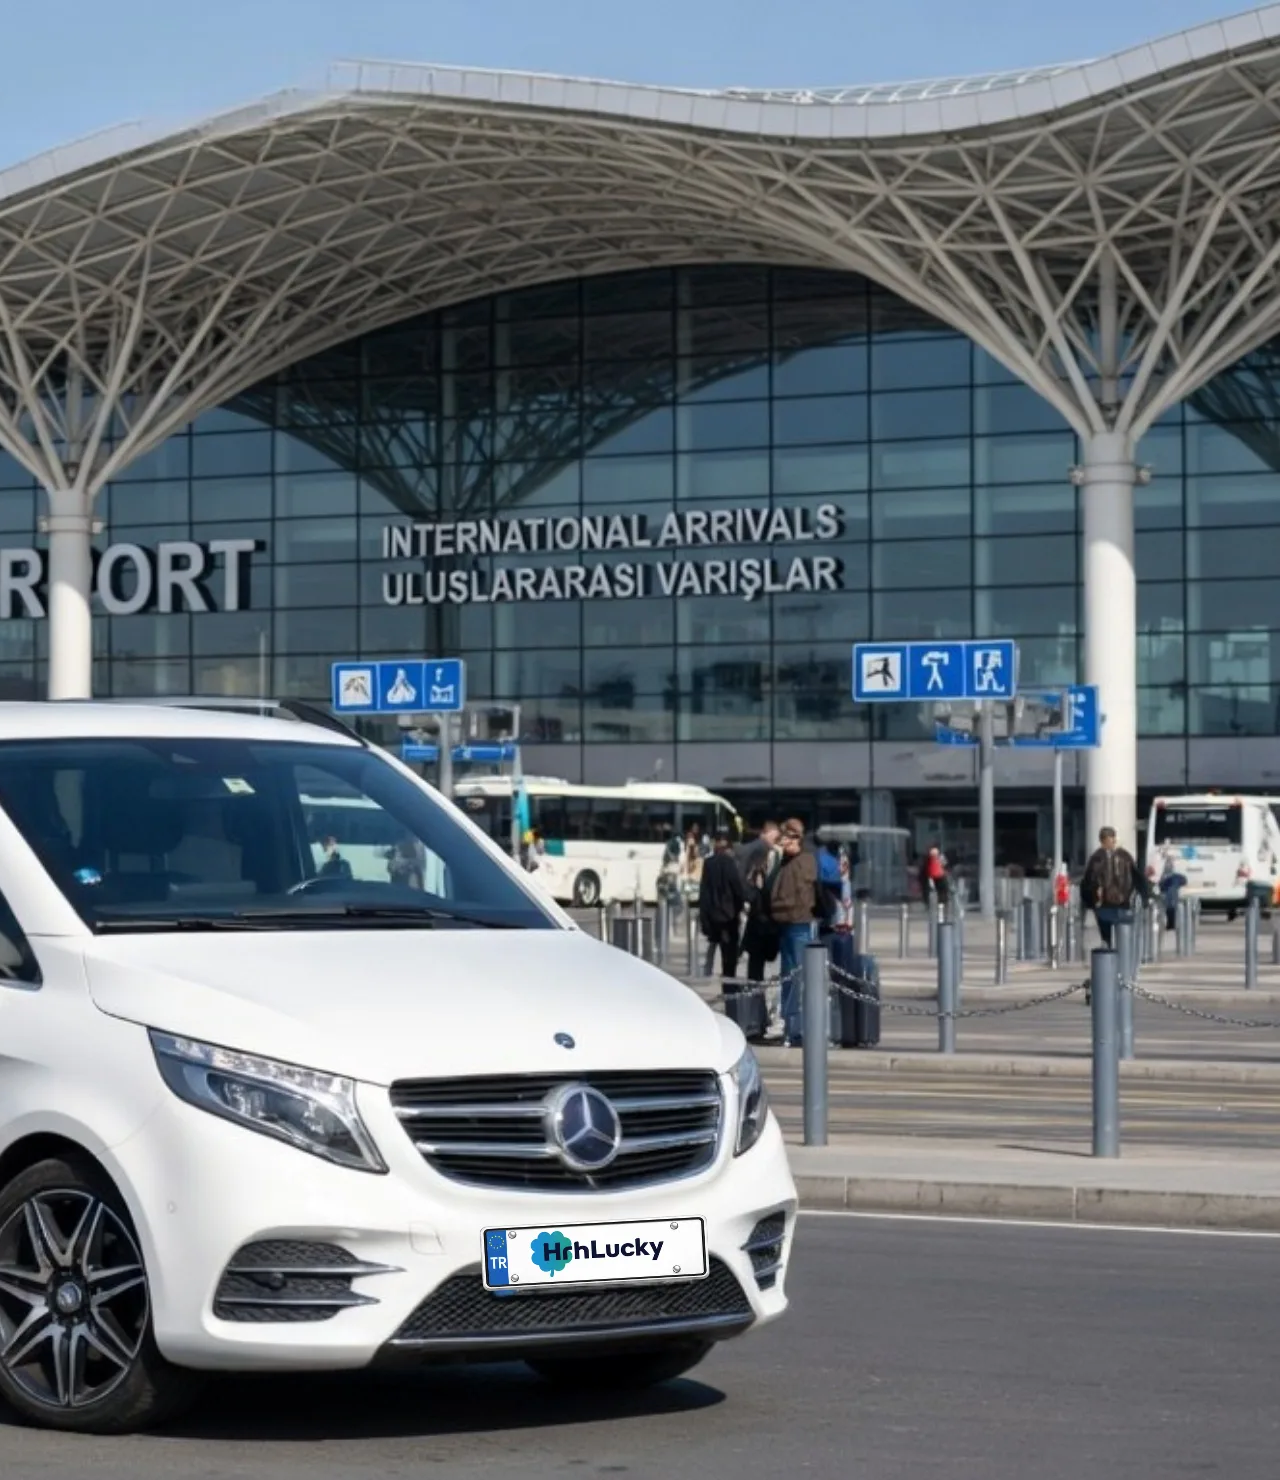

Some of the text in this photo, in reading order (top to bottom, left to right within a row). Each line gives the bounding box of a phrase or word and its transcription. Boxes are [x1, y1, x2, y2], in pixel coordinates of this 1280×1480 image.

[382, 504, 838, 559] INTERNATIONAL ARRIVALS
[382, 556, 838, 605] ULUSLARARASI VARIŞLAR
[490, 1256, 507, 1270] TR
[543, 1238, 664, 1262] HrhLucky
